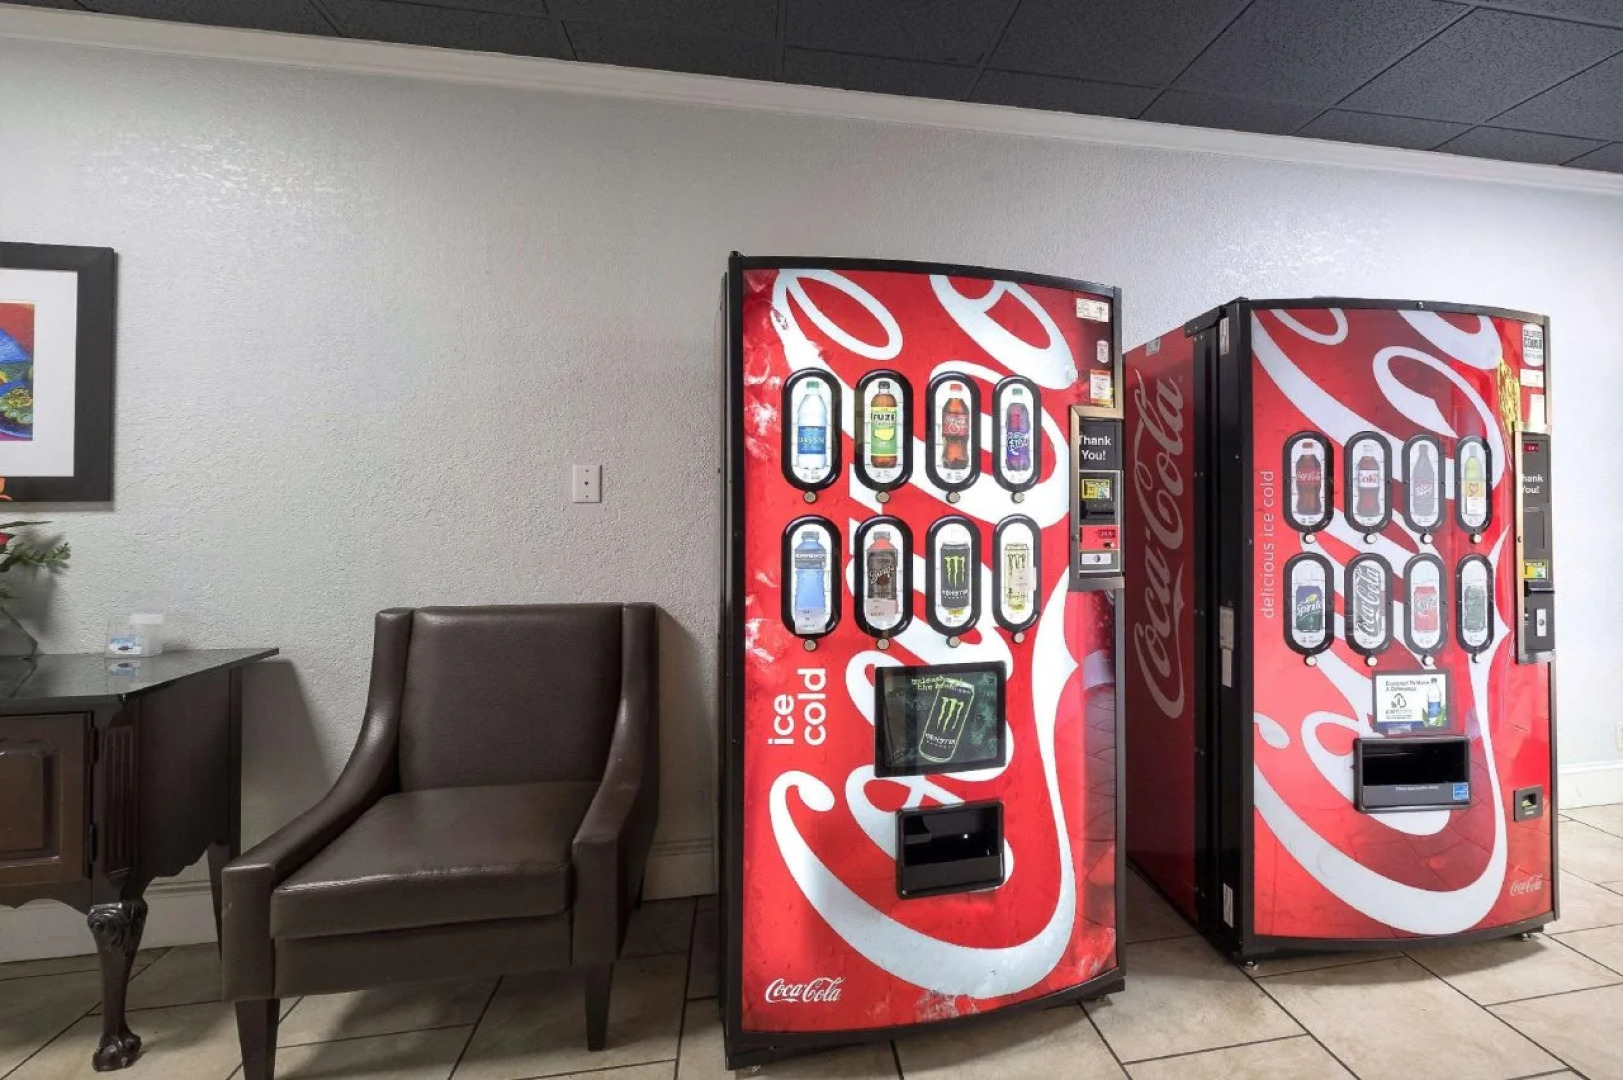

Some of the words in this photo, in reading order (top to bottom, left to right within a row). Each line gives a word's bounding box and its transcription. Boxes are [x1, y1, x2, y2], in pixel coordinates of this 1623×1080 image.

[1081, 450, 1106, 461] You!
[1260, 470, 1274, 509] cold
[1260, 512, 1274, 539] ice
[1260, 543, 1275, 619] delicious
[767, 694, 795, 745] ice
[797, 668, 827, 746] cold
